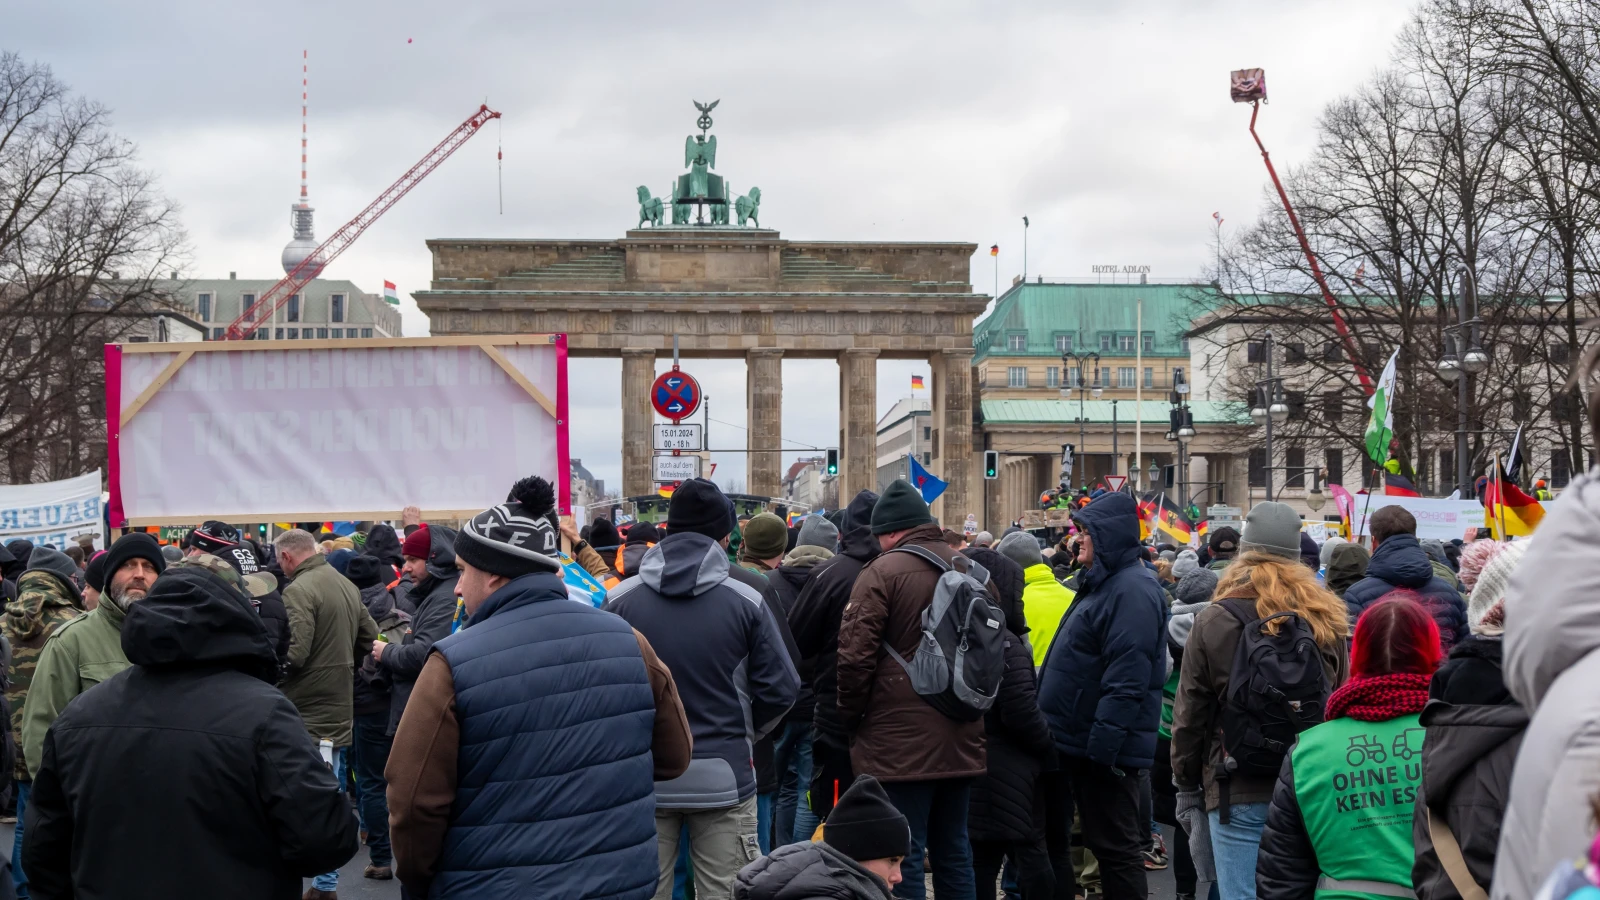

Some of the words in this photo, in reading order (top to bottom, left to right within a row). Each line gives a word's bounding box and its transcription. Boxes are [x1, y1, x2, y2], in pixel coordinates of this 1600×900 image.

[1092, 264, 1120, 273] HOTEL
[1122, 264, 1150, 273] ADLON
[661, 430, 694, 438] 15.01.2024
[664, 440, 672, 448] 00
[676, 440, 684, 448] 18
[686, 440, 690, 448] h
[232, 549, 254, 560] 63
[1332, 766, 1398, 791] OHNE
[1405, 763, 1421, 781] U
[1336, 790, 1384, 814] KEIN
